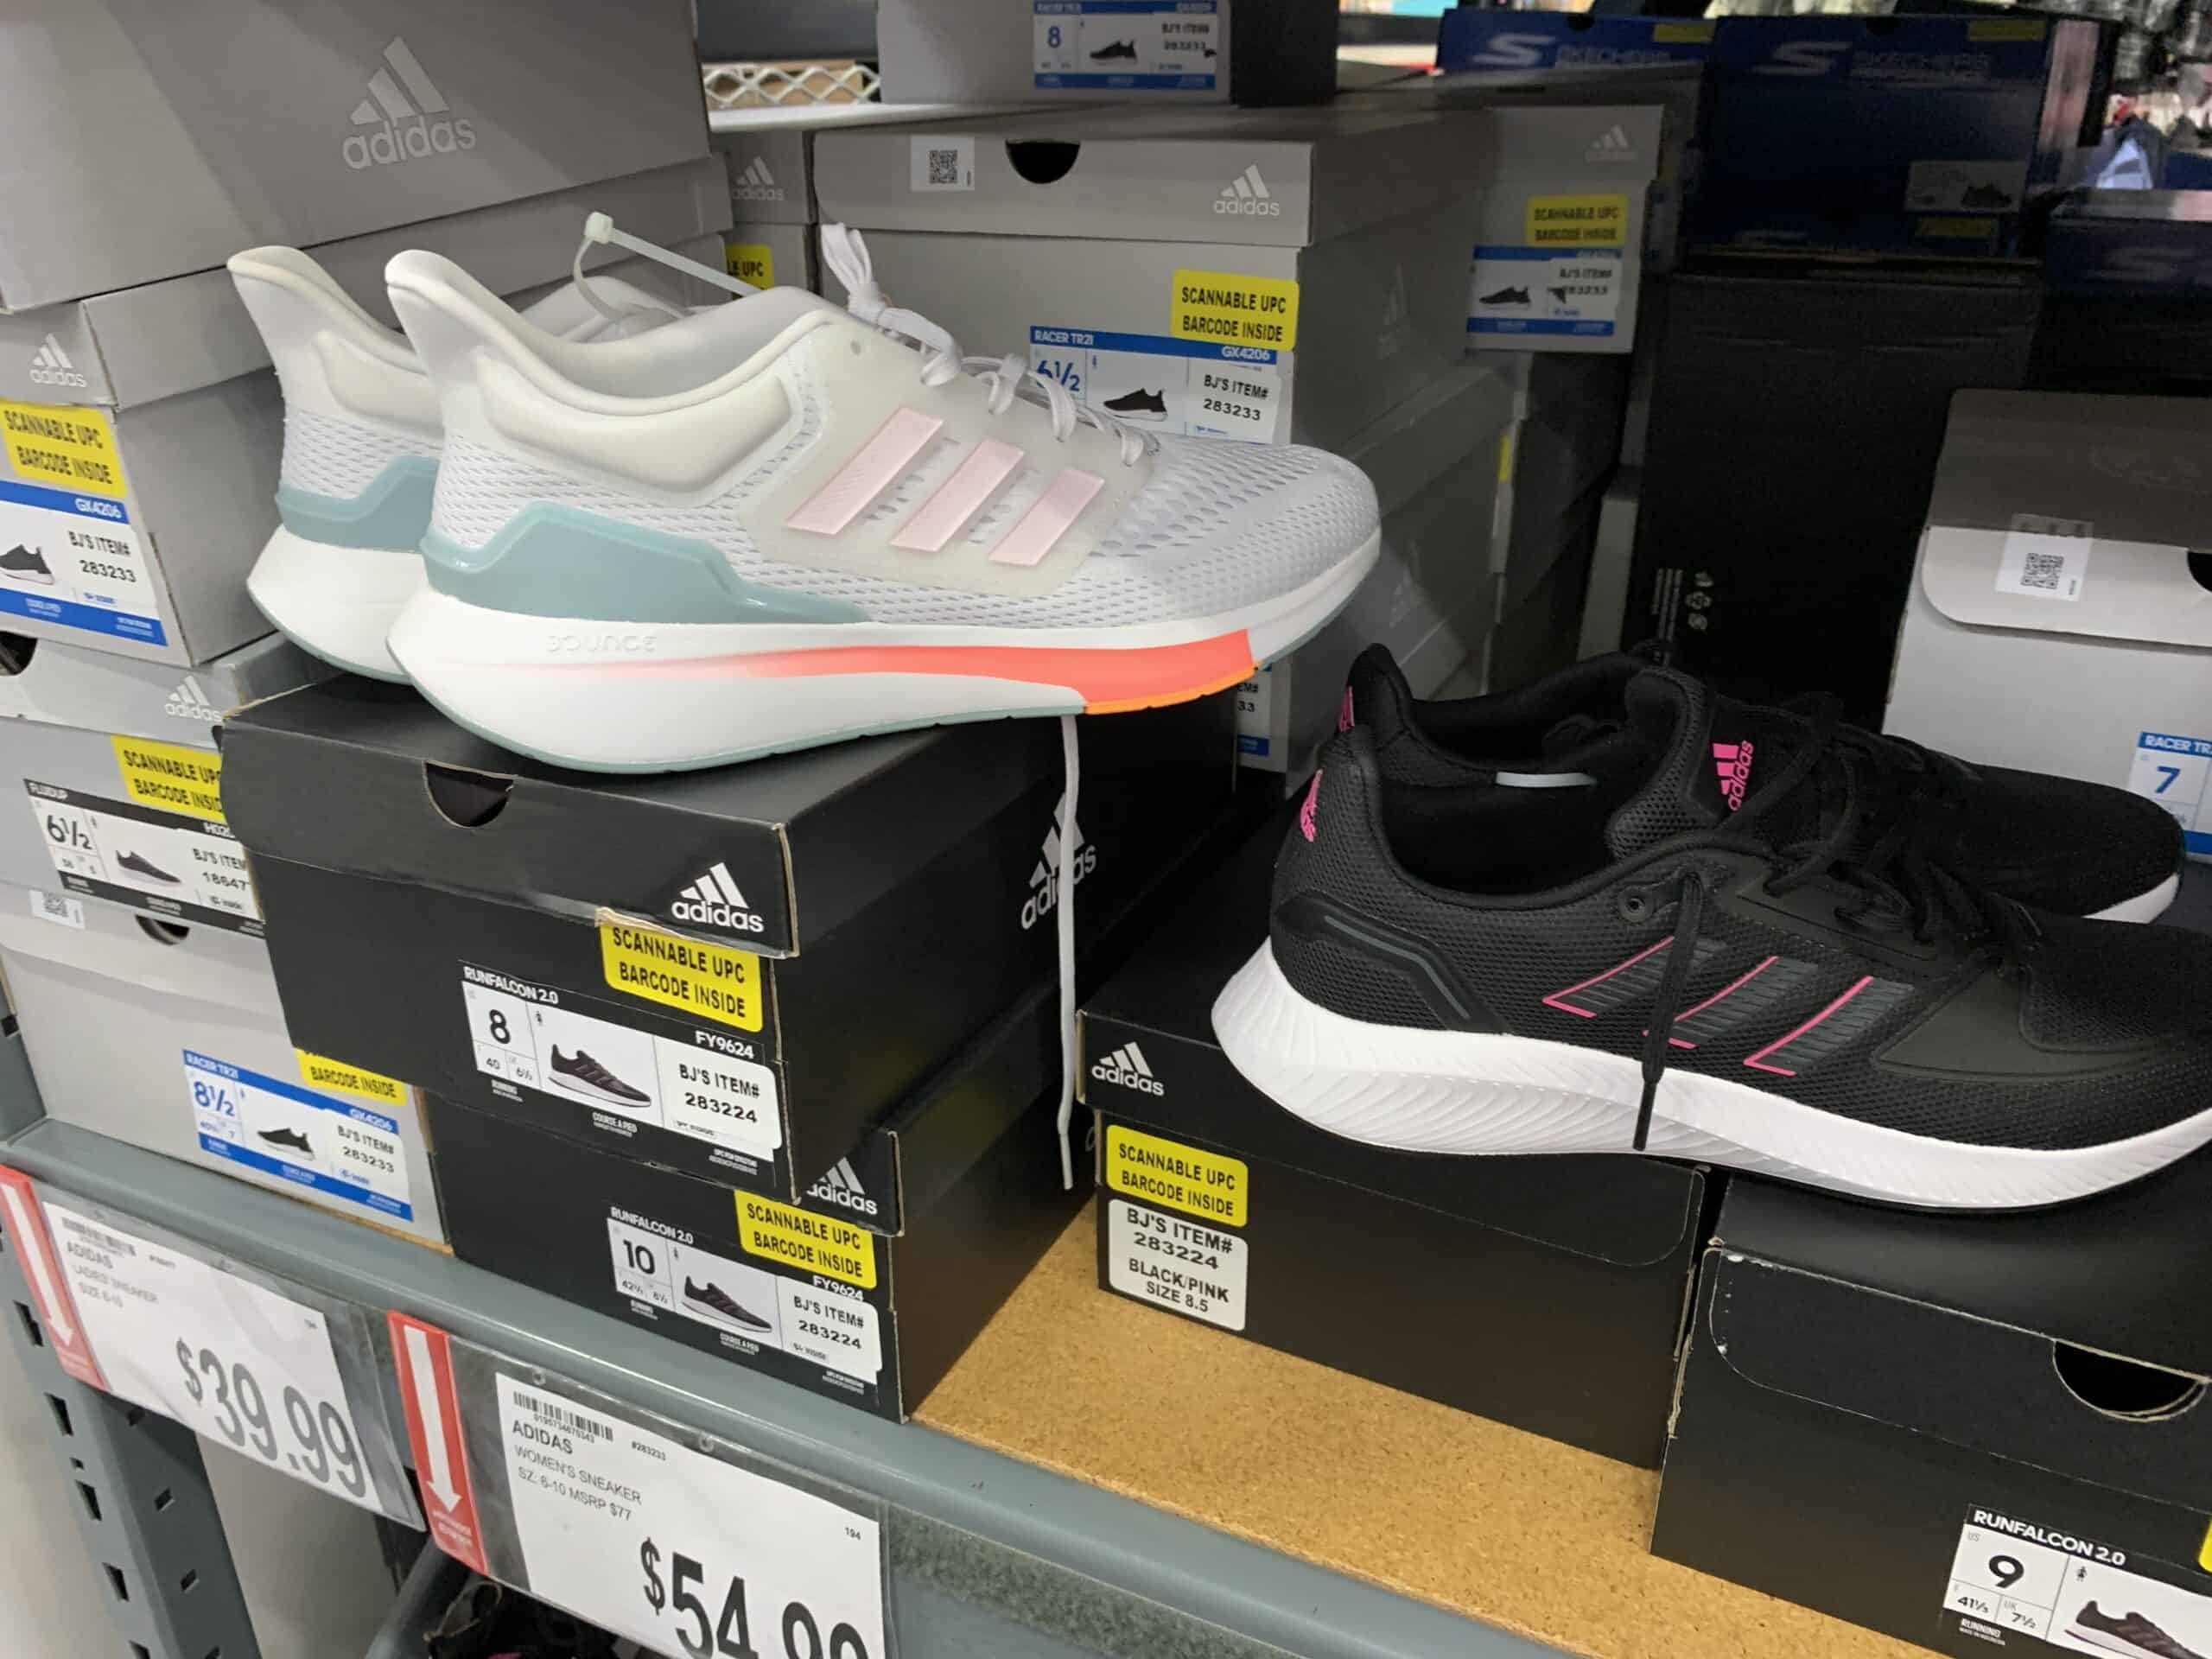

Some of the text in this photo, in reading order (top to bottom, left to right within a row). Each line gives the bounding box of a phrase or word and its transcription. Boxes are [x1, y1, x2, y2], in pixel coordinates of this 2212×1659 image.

[1047, 26, 1061, 48] 8
[343, 115, 476, 169] adidas
[1214, 199, 1280, 216] adidas
[1182, 286, 1286, 314] SCANNABLE UPC
[1034, 330, 1070, 344] RACER
[1183, 315, 1283, 342] BARCODE INSIDE
[1221, 346, 1270, 361] GX4206
[29, 368, 87, 388] adidas
[1204, 374, 1268, 399] BJ'S ITEM#
[1204, 398, 1261, 421] 283233
[3, 410, 103, 449] SCANNABLE UPC
[16, 445, 113, 485] BARCODE INSIDE
[68, 531, 131, 556] BJ'S ITEM#
[79, 560, 137, 582] 283233
[165, 702, 222, 722] adidas
[2145, 734, 2191, 752] RACER
[124, 750, 198, 781] SCANNABLE
[1728, 740, 1754, 810] adidas
[2156, 765, 2182, 794] 7
[134, 778, 222, 813] BARCODE INSID
[193, 848, 219, 865] BJ'S
[202, 871, 250, 891] 18647
[1021, 845, 1096, 931] adias
[671, 900, 765, 932] adidas
[613, 926, 745, 984] SCANNABLE UPC
[463, 966, 559, 1004] RUNFALCON 2.0
[620, 961, 746, 1018] BARCODE INSIDE
[489, 1008, 512, 1045] 8
[695, 1030, 754, 1059] FY9624
[486, 1057, 501, 1071] 40
[310, 1065, 397, 1098] BARCODE INSIDE
[679, 1064, 760, 1099] BJ'S ITEM#
[1091, 1065, 1165, 1097] adidas
[684, 1091, 758, 1123] 283224
[338, 1125, 395, 1155] BJ'S ITEM#
[343, 1145, 396, 1173] 283233
[1119, 1142, 1236, 1191] SCANNABLE UPC
[1122, 1169, 1234, 1217] BARCODE INSIDE
[611, 1206, 695, 1245] RUNFALCON 2.0
[747, 1202, 861, 1250] SCANNABLE UPC
[1127, 1207, 1234, 1254] BJ'S ITEM#
[67, 1240, 114, 1269] ADIDAS
[622, 1239, 656, 1275] 10
[753, 1230, 862, 1278] BARCODE INSIDE
[1133, 1230, 1219, 1270] 283224
[812, 1274, 864, 1302] FY9624
[1128, 1257, 1230, 1304] BLACK/PINK
[794, 1295, 865, 1329] BJ'S ITEM#
[1147, 1281, 1209, 1313] SIZE 8.5
[798, 1319, 862, 1350] 283224
[175, 1337, 366, 1498] $39.99
[512, 1420, 574, 1455] ADIDAS
[514, 1444, 643, 1506] WOMEN'S SNEAKER
[540, 1474, 567, 1497] 6-10
[569, 1485, 607, 1510] MSRP
[610, 1502, 632, 1522] $77
[844, 1526, 861, 1541] 194
[1974, 1509, 2127, 1567] RUNFALCON 2.0
[1987, 1554, 2026, 1590] 9
[1961, 1618, 2002, 1638] RUNNING
